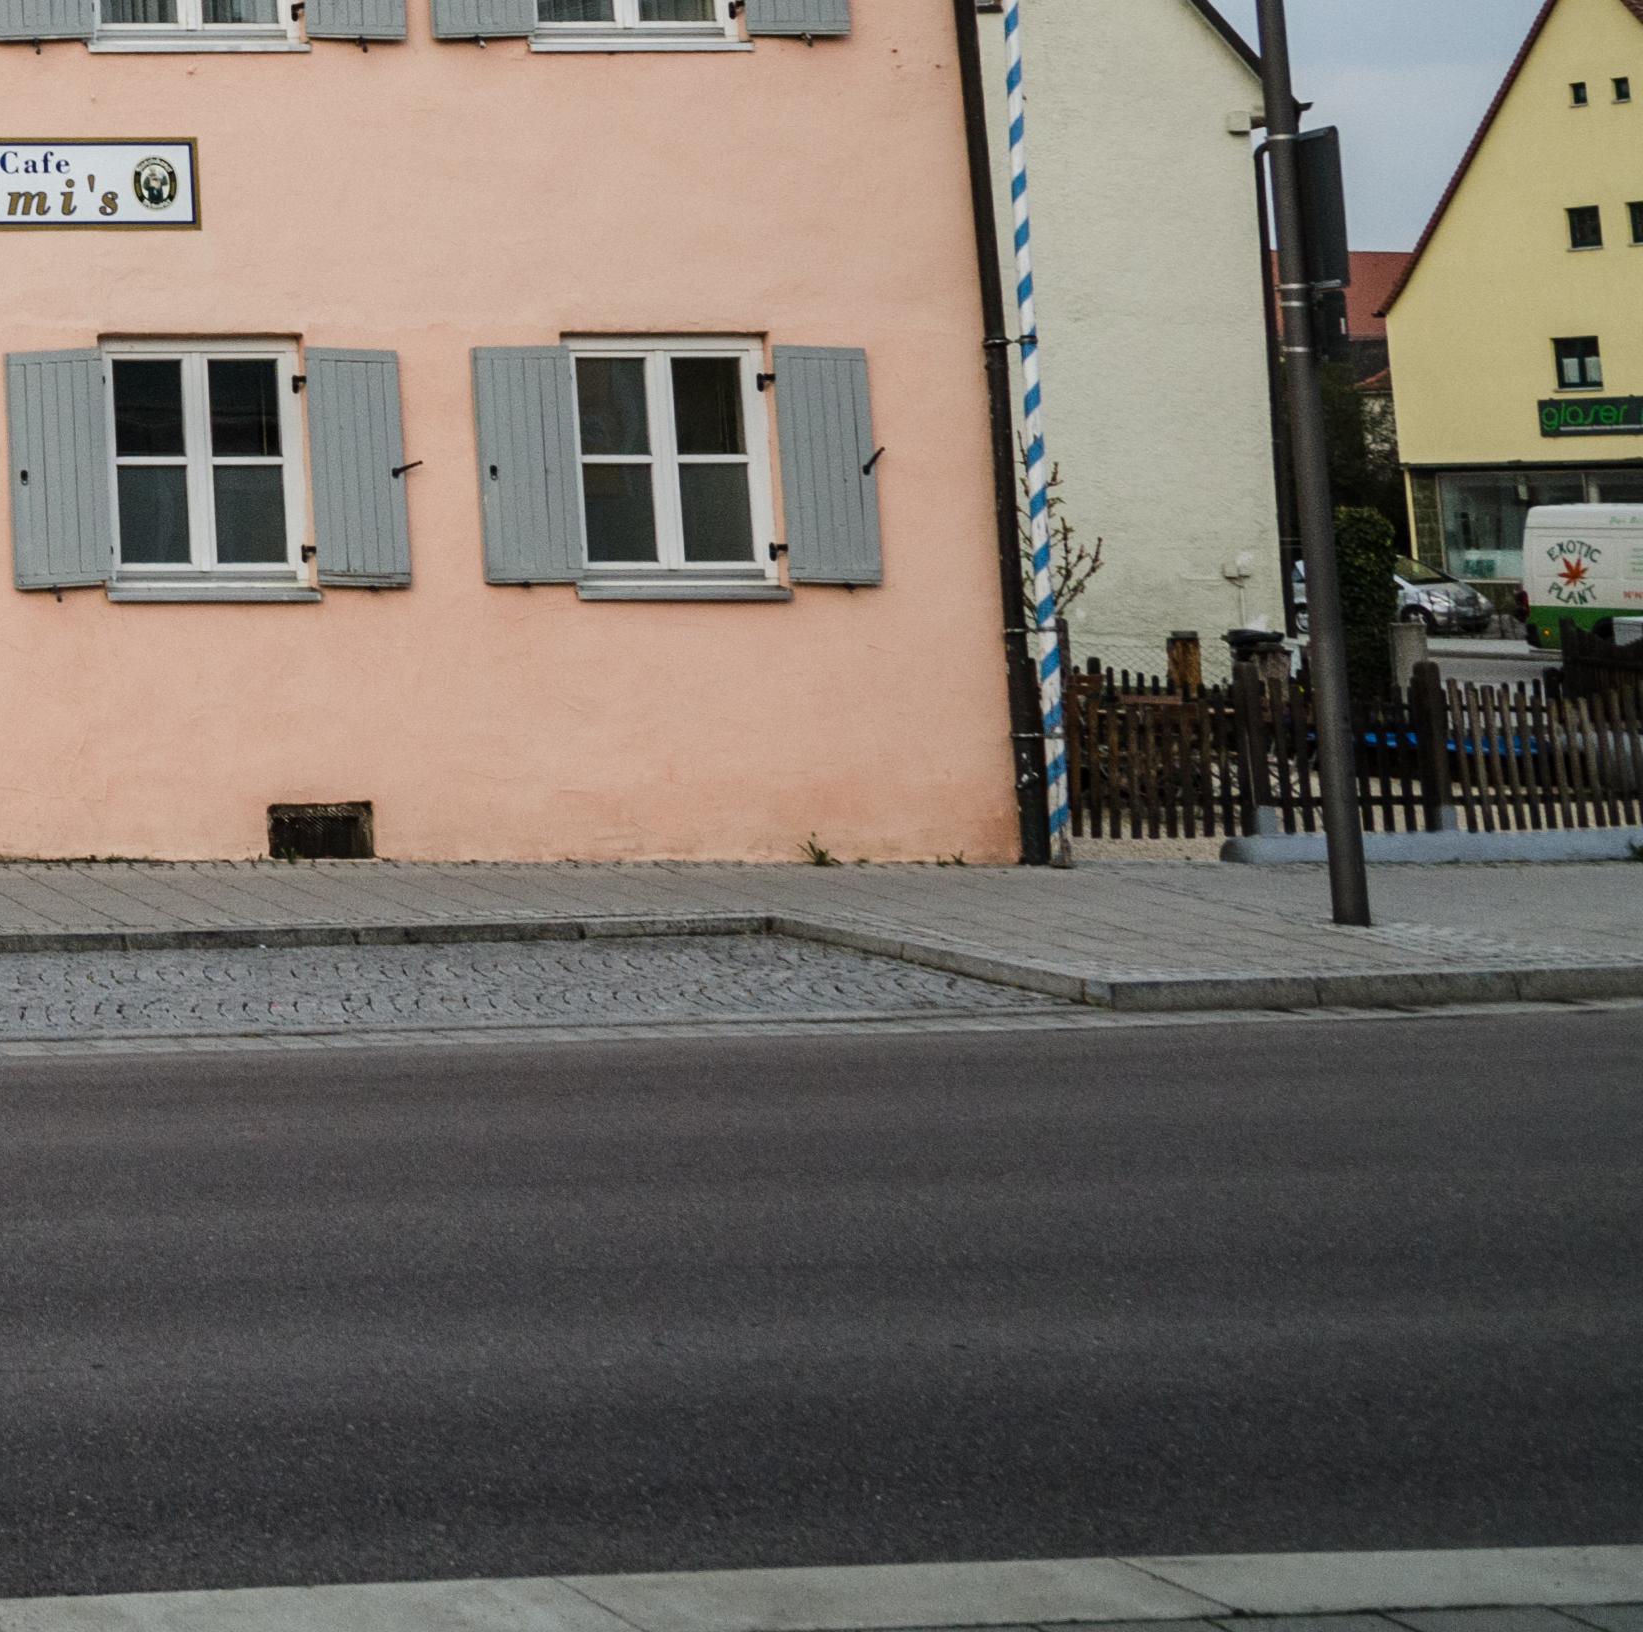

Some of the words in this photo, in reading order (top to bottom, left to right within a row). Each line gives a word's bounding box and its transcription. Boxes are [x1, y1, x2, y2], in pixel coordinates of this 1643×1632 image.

[0, 151, 72, 174] Cafe
[1546, 539, 1602, 563] EXOTIC
[1548, 581, 1597, 605] PLANT
